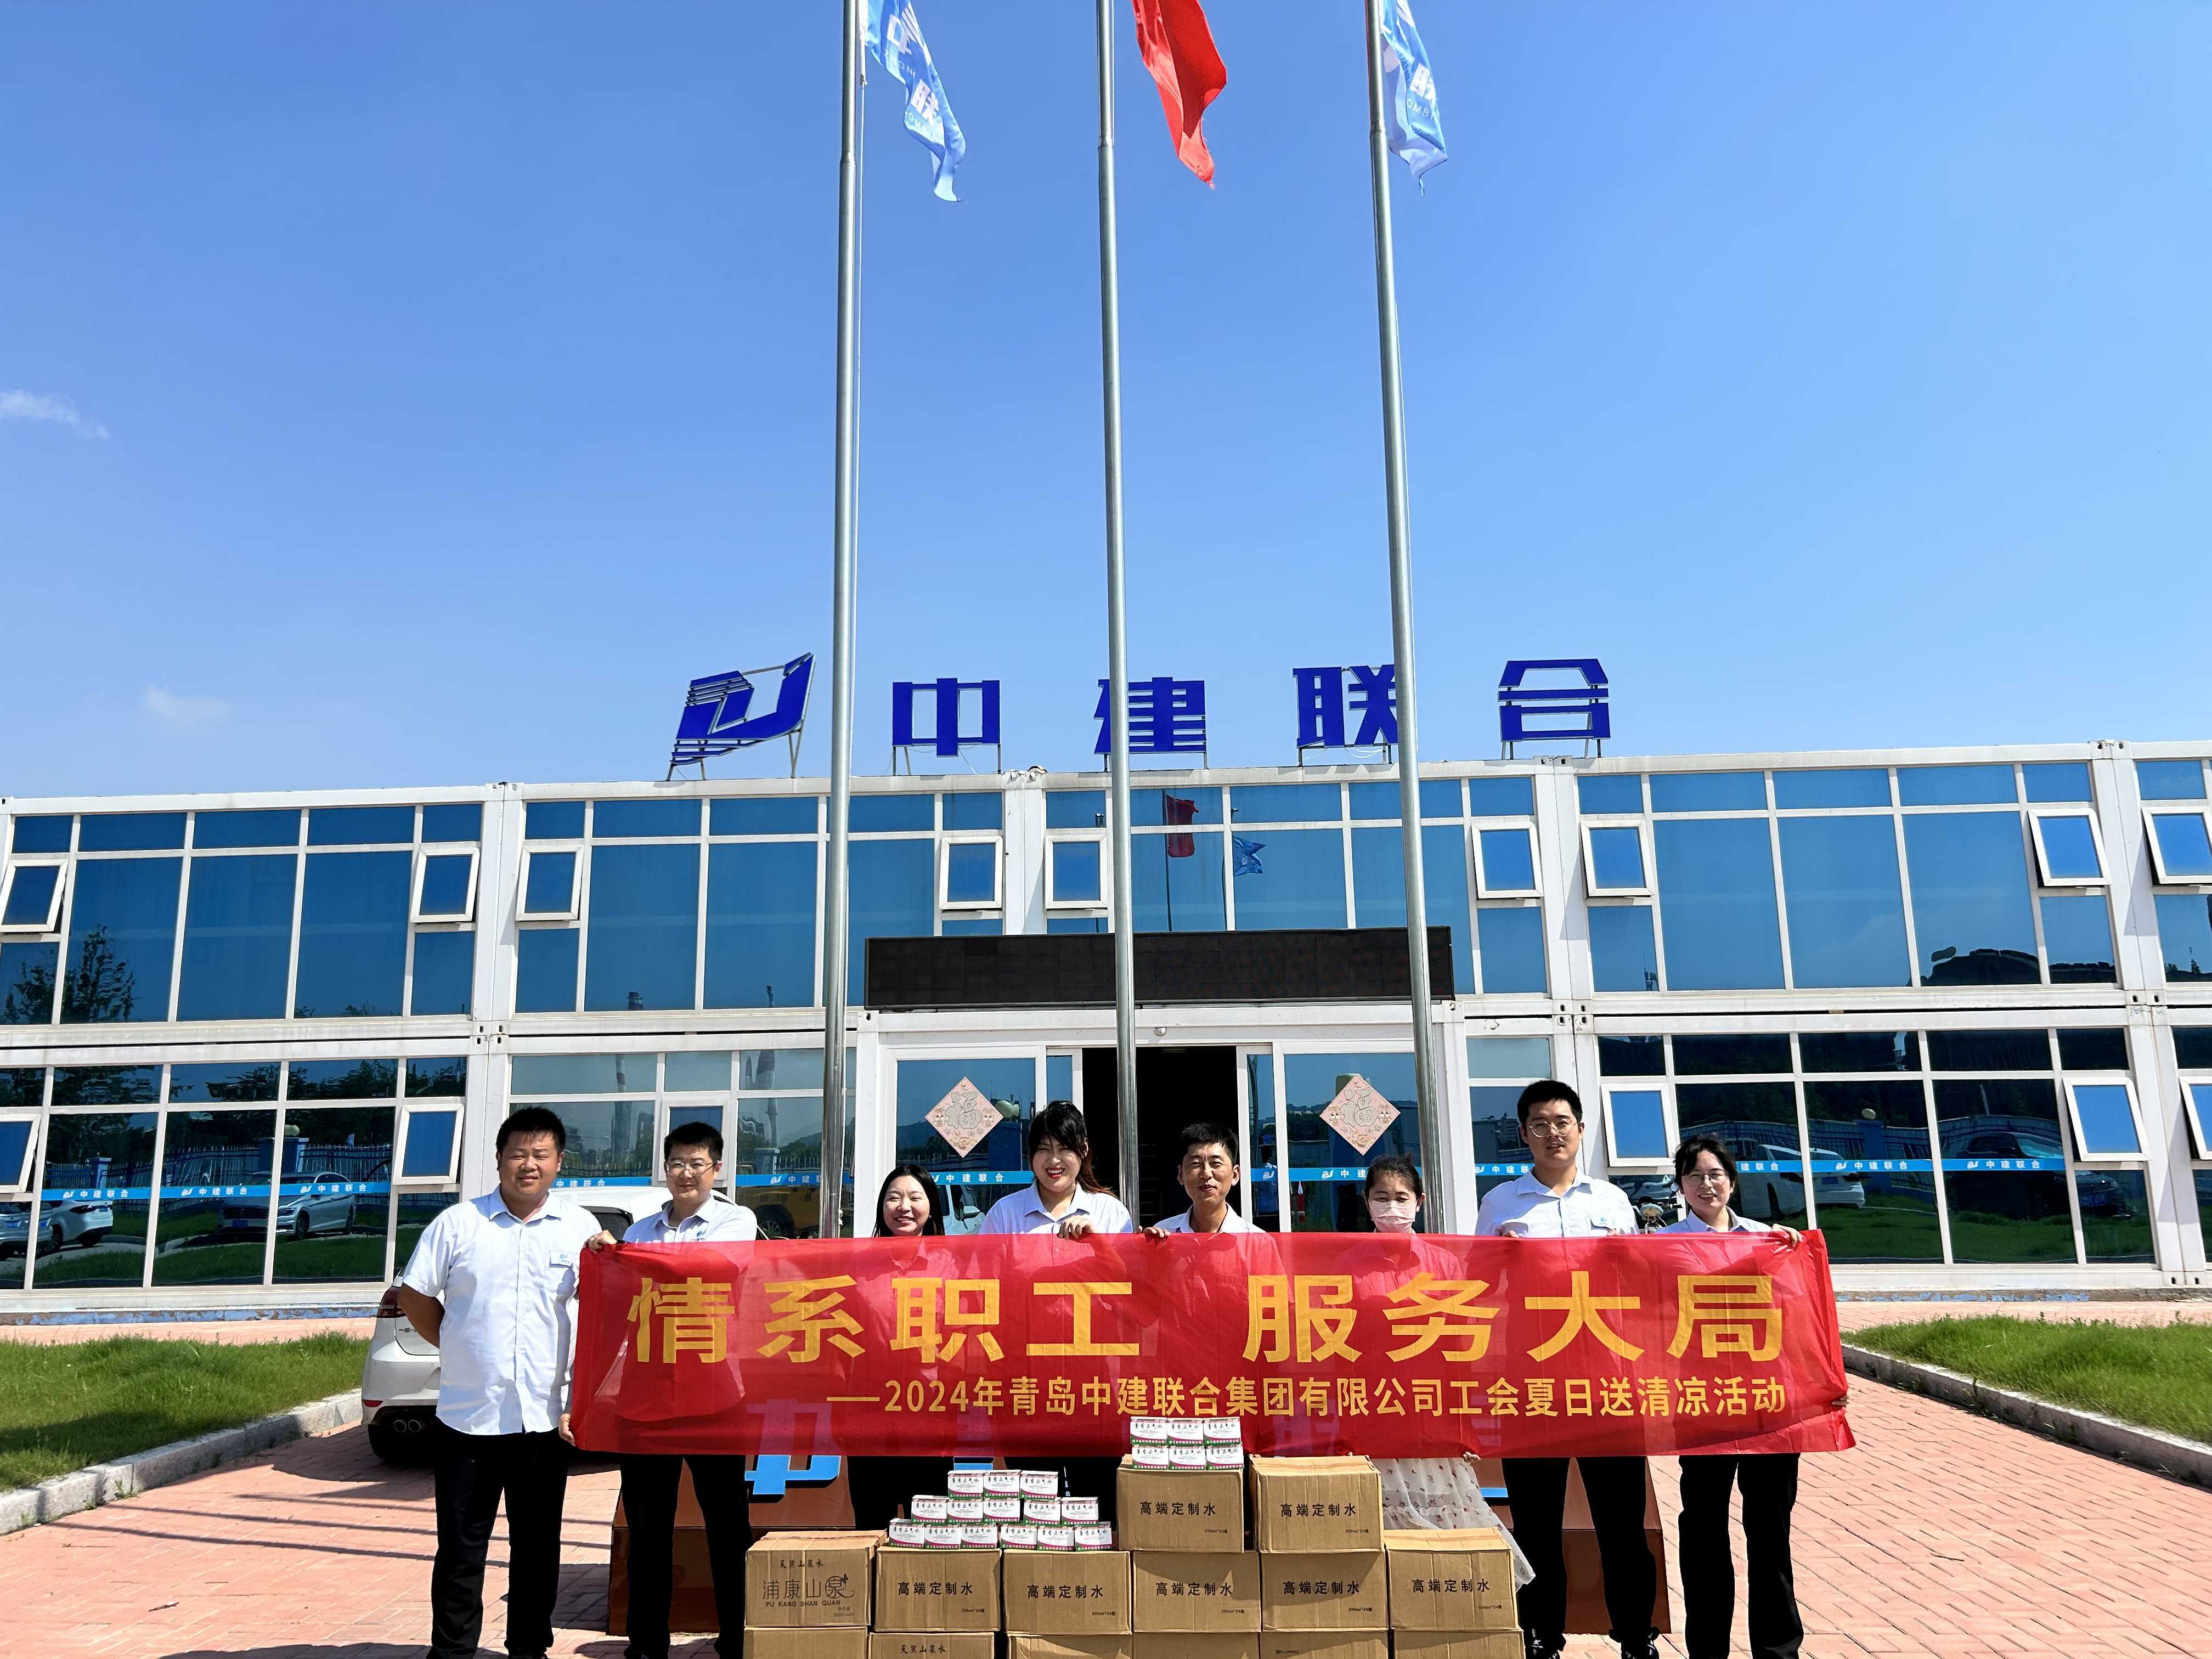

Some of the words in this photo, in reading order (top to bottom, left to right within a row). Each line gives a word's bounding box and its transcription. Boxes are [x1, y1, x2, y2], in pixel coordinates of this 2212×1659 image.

[892, 658, 1610, 757] 中建联合
[1854, 1160, 1908, 1170] 中建联合
[1986, 1159, 2040, 1169] 中建联合
[556, 1179, 606, 1187] 中建联合
[946, 1173, 1004, 1182] 中建联合
[80, 1190, 128, 1199] 中建联合
[199, 1186, 247, 1196] 中建联合
[318, 1184, 366, 1193] 中建联合
[628, 1276, 1139, 1363] 情系职工
[1242, 1271, 1782, 1363] 服务大局
[1139, 1501, 1216, 1516] 高端定制水
[1280, 1503, 1357, 1517] 高端定制水
[780, 1559, 824, 1569] 天然山泉水
[763, 1576, 845, 1599] 浦康山泉
[898, 1581, 973, 1596] 高端定制水
[1027, 1584, 1104, 1599] 高端定制水
[1155, 1582, 1233, 1596] 高端定制水
[1283, 1581, 1360, 1595] 高端定制水
[1412, 1578, 1490, 1594] 高端定制水
[900, 1644, 946, 1654] 天然山泉水
